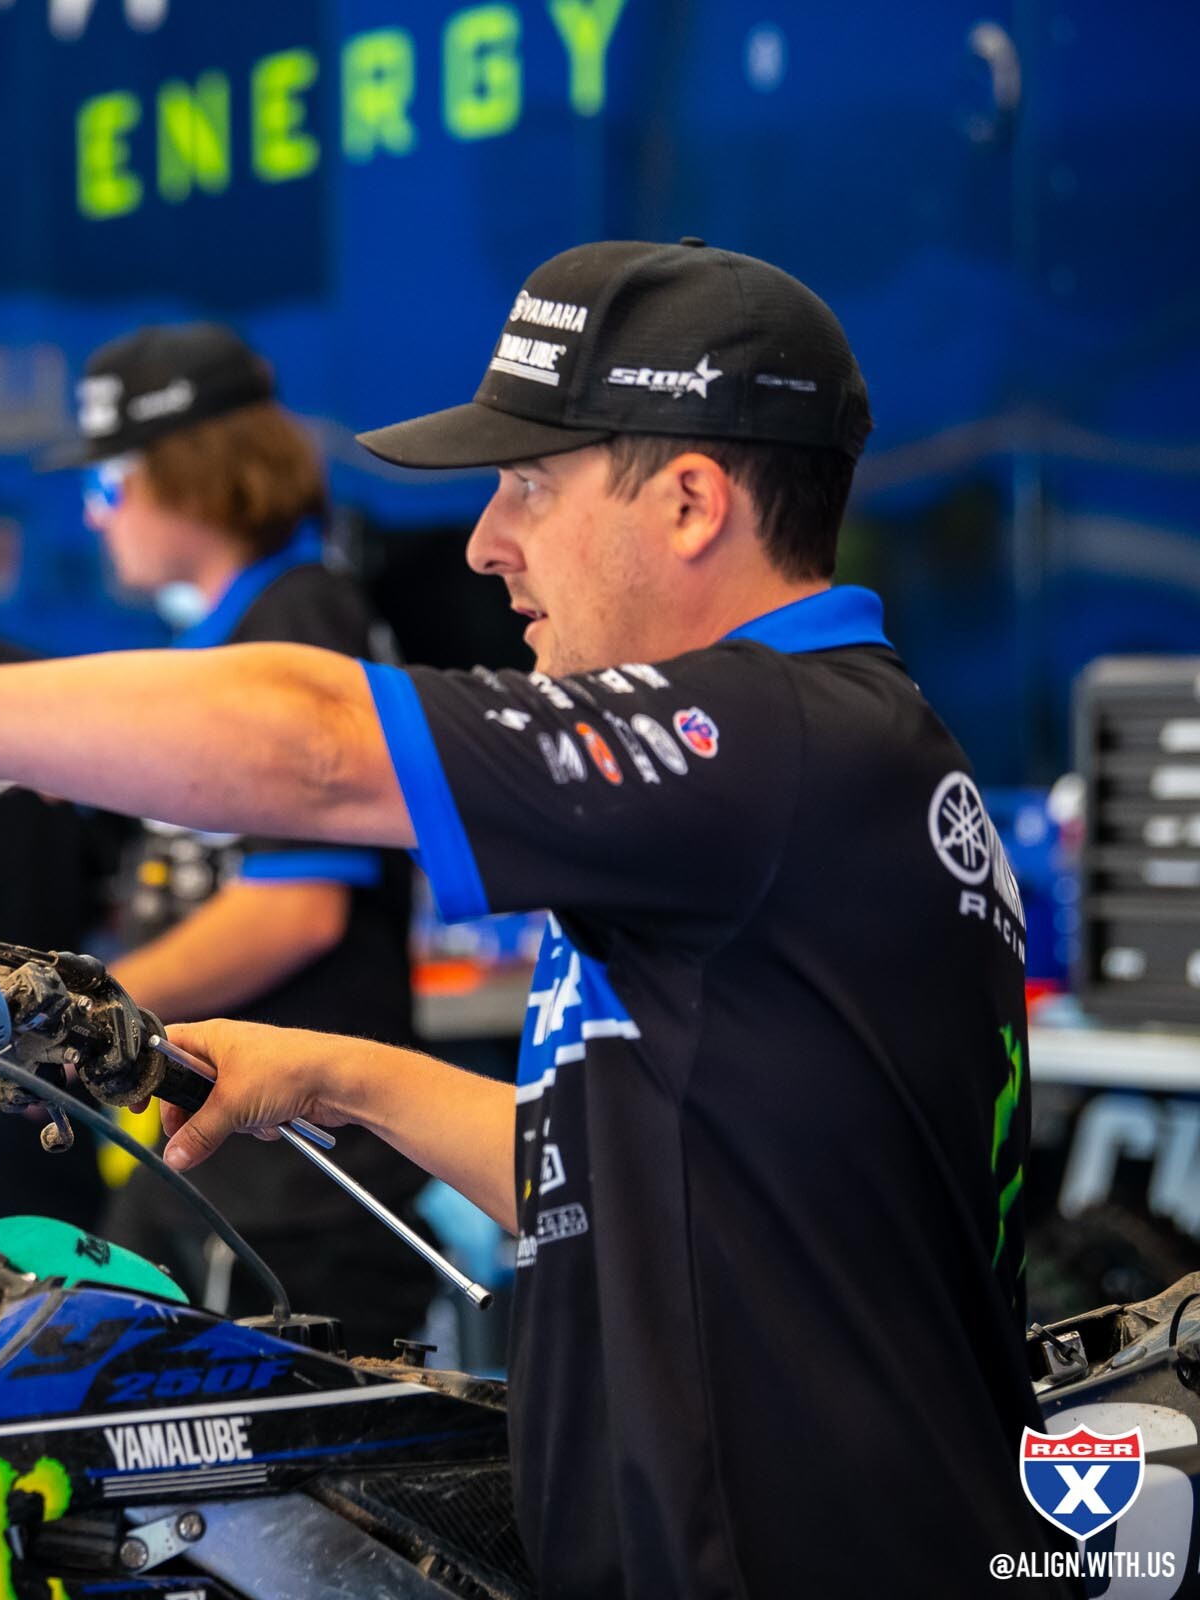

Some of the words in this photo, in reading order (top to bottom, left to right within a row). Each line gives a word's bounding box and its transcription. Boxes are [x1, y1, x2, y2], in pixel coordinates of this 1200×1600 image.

[77, 0, 626, 220] ENERGY
[521, 297, 588, 333] YAMAHA
[497, 333, 560, 371] AMALUBE
[958, 890, 1026, 965] RACIN
[104, 1359, 296, 1404] 250F
[104, 1416, 253, 1471] YAMALUBE
